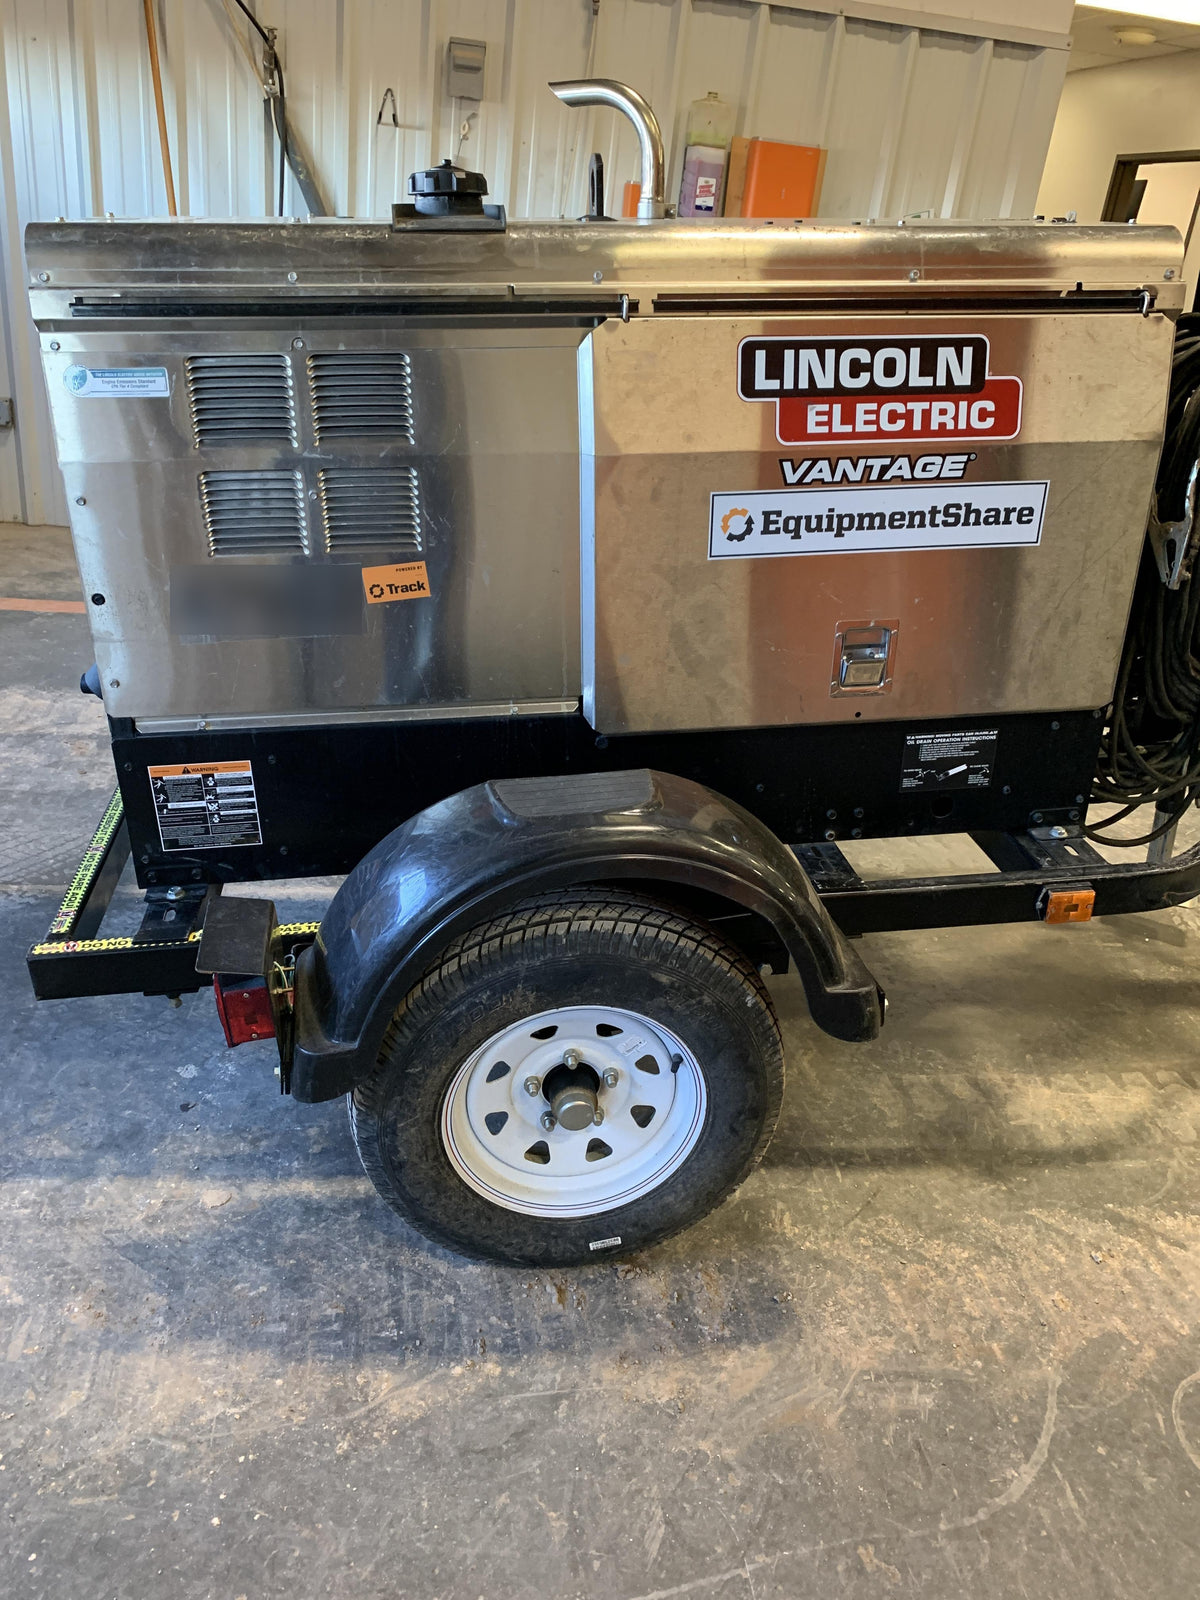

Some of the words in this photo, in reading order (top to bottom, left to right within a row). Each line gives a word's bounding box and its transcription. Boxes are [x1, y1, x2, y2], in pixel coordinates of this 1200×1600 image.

[754, 346, 973, 390] LINCOLN
[807, 400, 996, 434] ELECTRIC
[781, 454, 970, 484] VANTAGE
[760, 502, 1035, 540] EquipmentShare
[386, 580, 426, 594] Track
[73, 873, 87, 891] PARE
[81, 941, 104, 949] DO
